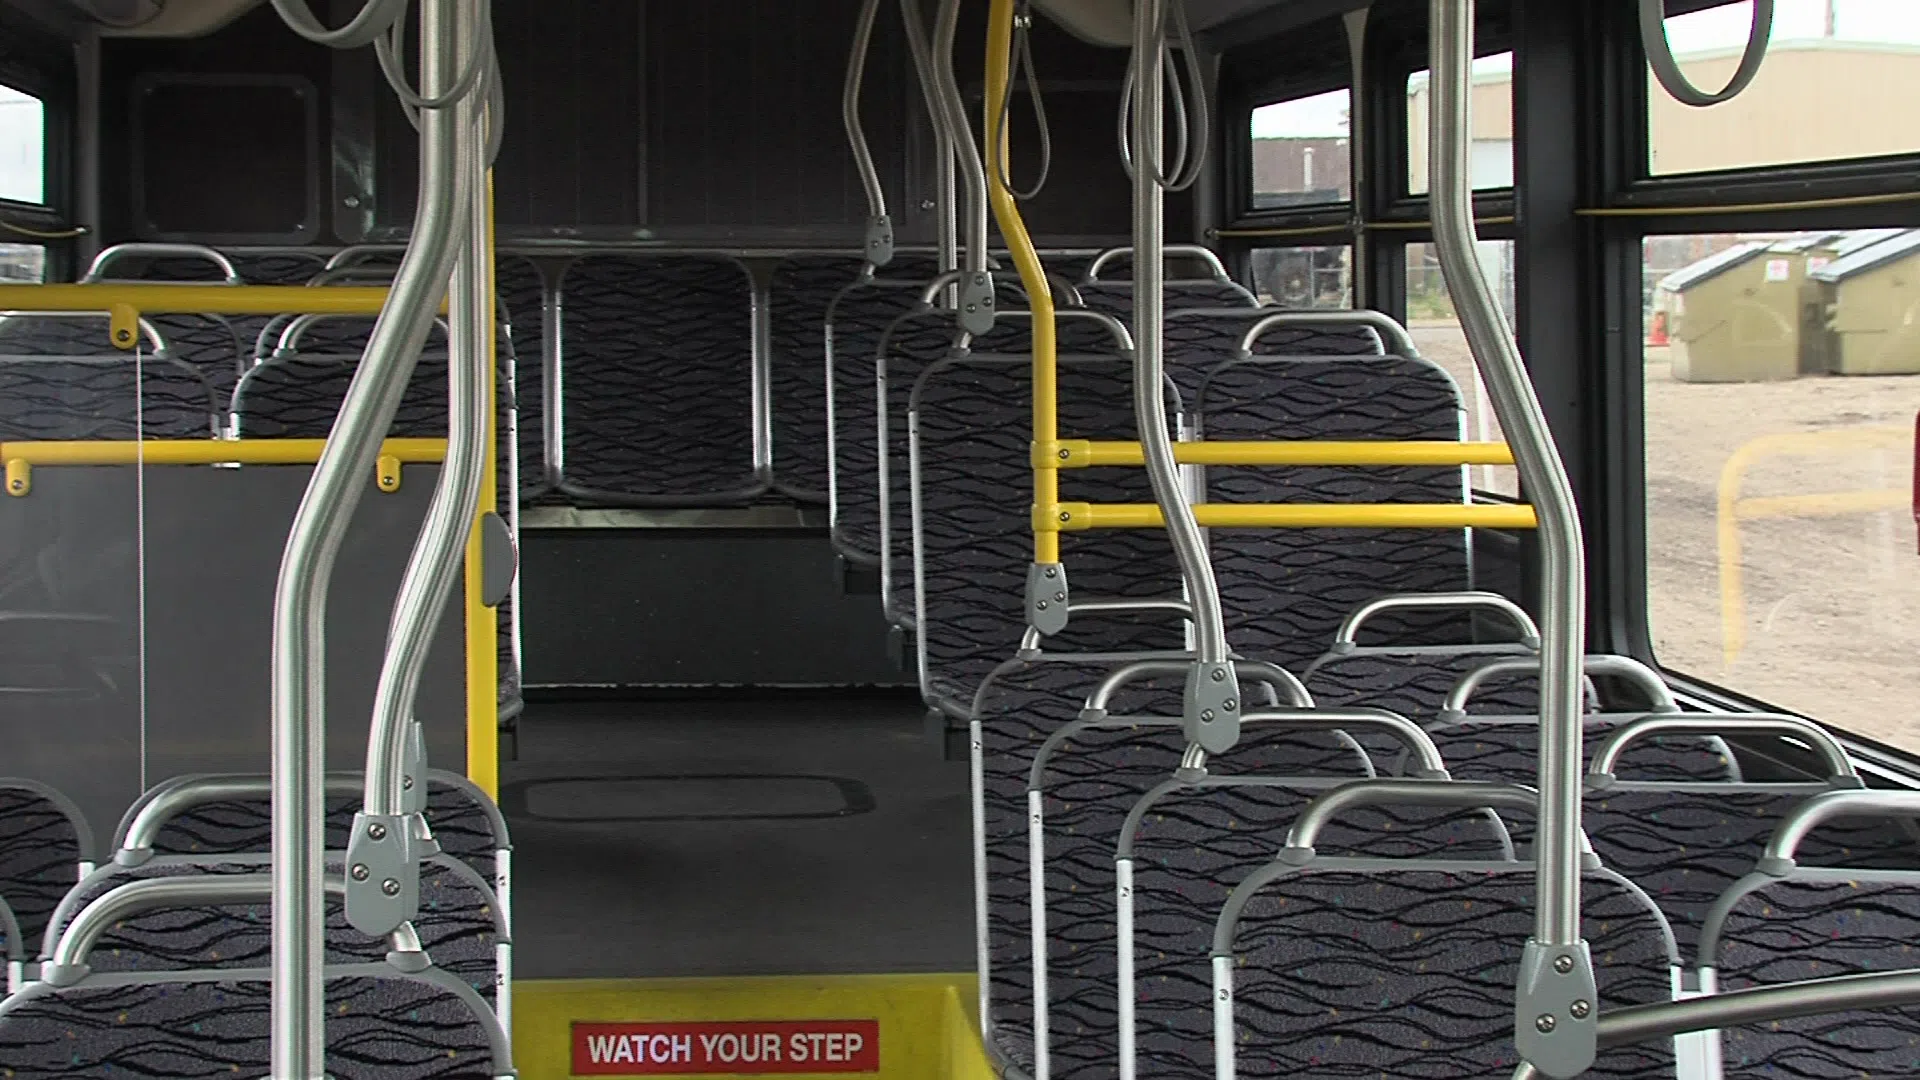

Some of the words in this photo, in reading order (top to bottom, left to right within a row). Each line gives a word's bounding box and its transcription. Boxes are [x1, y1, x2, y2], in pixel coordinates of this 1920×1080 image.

[587, 1033, 692, 1062] WATCH
[698, 1033, 782, 1062] YOUR
[788, 1033, 864, 1062] STEP
